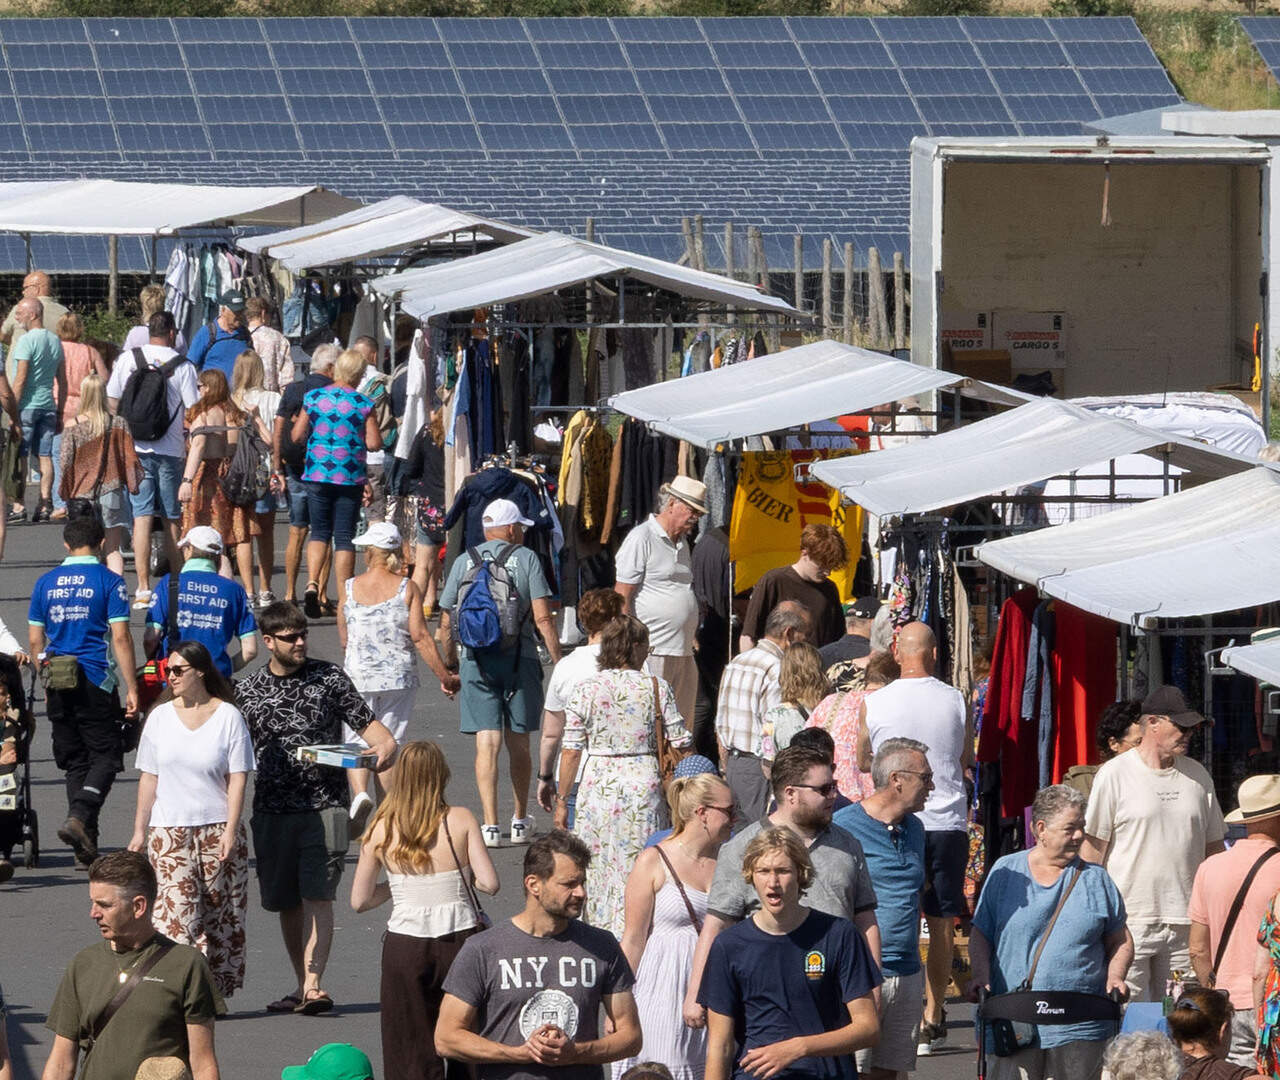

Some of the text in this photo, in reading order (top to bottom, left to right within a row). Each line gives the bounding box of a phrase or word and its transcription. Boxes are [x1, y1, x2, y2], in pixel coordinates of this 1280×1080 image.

[746, 486, 795, 524] BIER
[56, 575, 86, 587] EHBO
[186, 581, 218, 594] EHBO
[47, 587, 95, 600] FIRST AID
[177, 593, 229, 609] FIRST AID
[498, 955, 597, 990] N.Y CO
